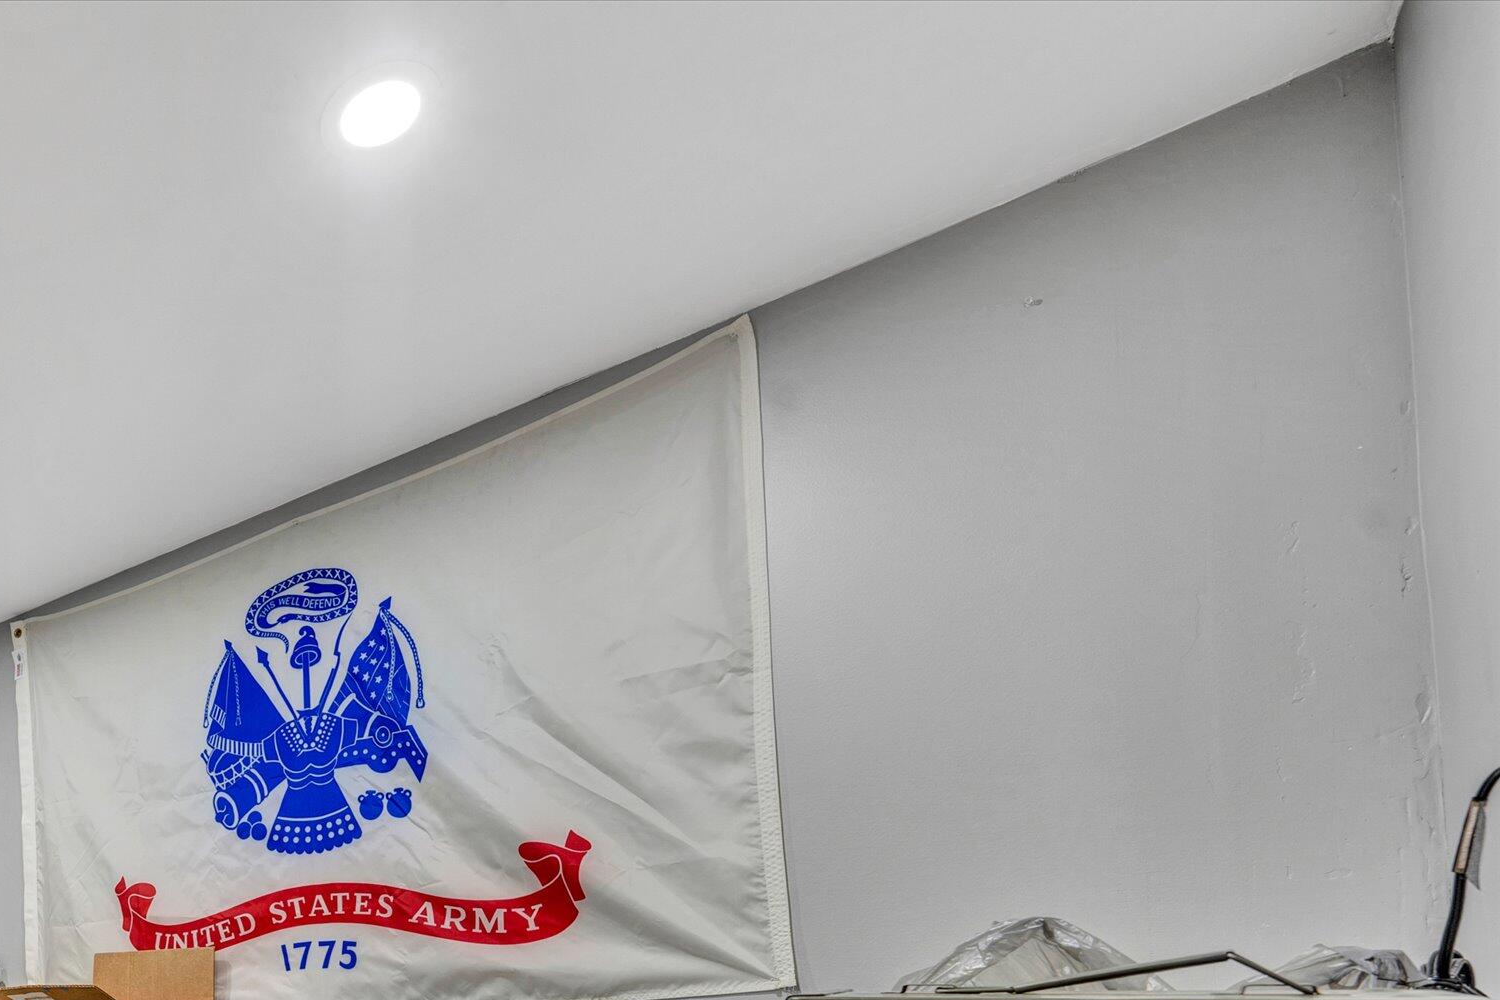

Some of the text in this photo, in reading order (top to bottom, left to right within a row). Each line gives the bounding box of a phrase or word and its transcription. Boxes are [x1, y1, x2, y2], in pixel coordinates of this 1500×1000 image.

[260, 601, 276, 618] THIS
[302, 597, 341, 609] DEFEND
[154, 892, 543, 950] UNITED STATES ARMY
[281, 940, 358, 972] 1775
